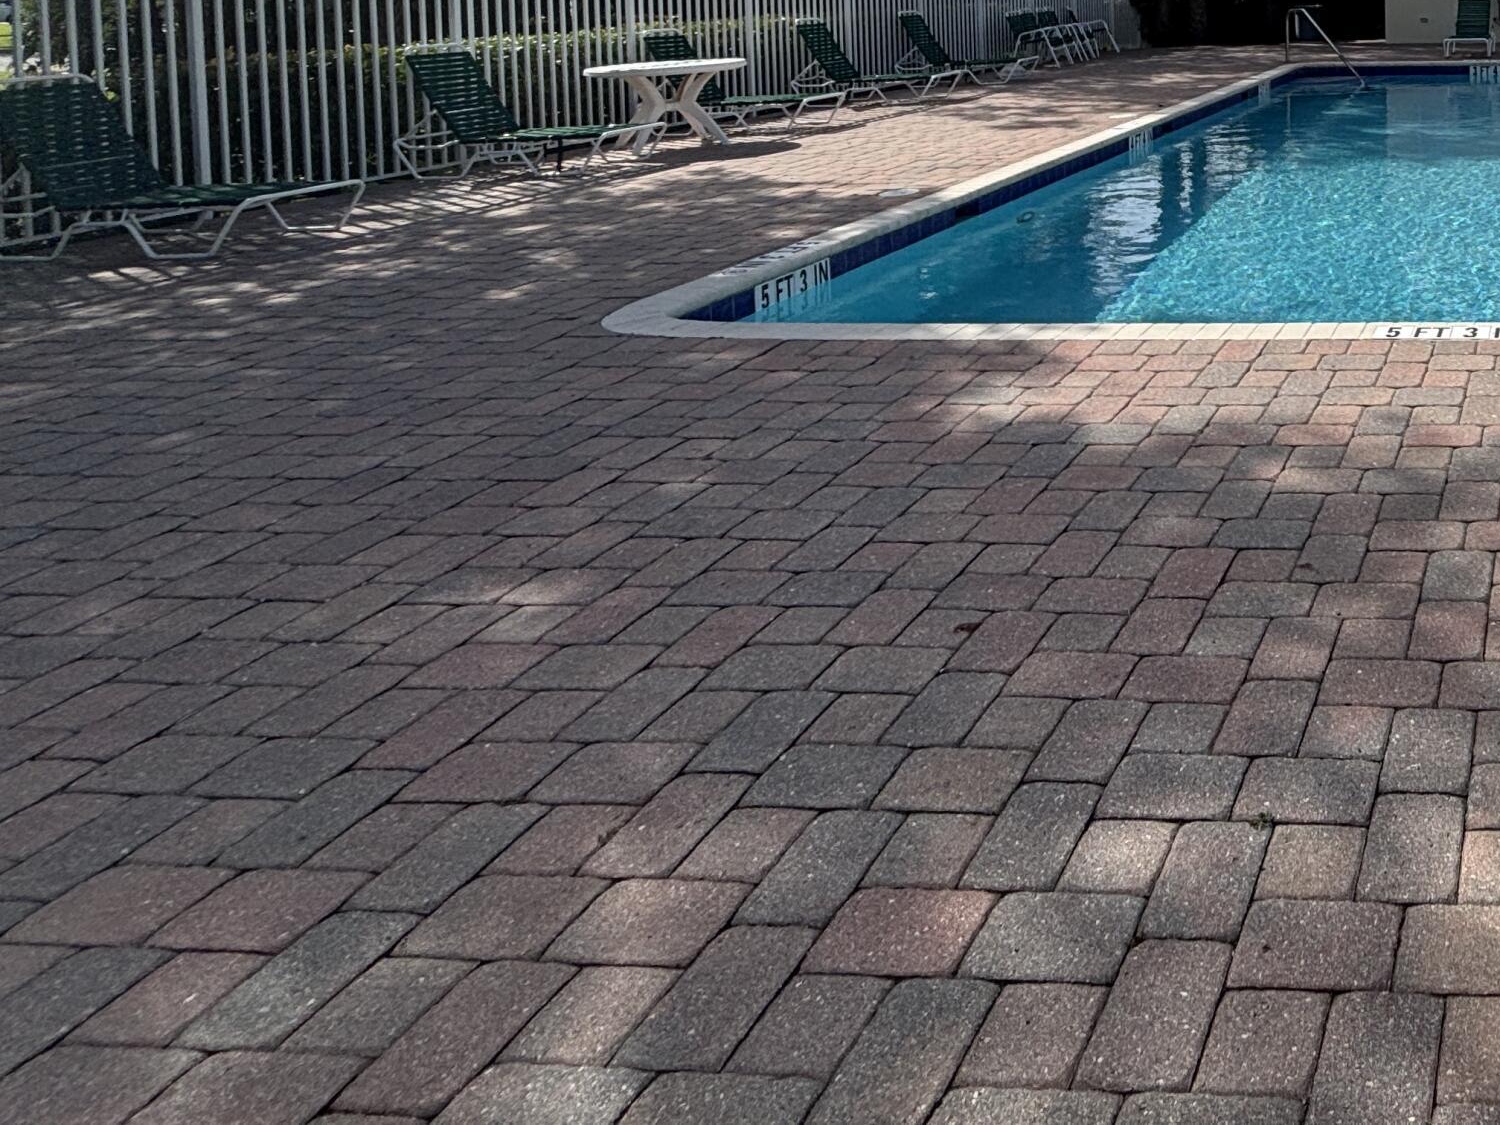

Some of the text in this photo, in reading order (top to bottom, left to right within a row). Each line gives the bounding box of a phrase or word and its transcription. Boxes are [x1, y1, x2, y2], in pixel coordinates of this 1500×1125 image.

[1480, 65, 1490, 76] FT
[761, 260, 829, 308] 5 FT 3 IN
[1386, 327, 1402, 338] 5
[1413, 327, 1450, 338] FT
[1463, 327, 1478, 338] 3
